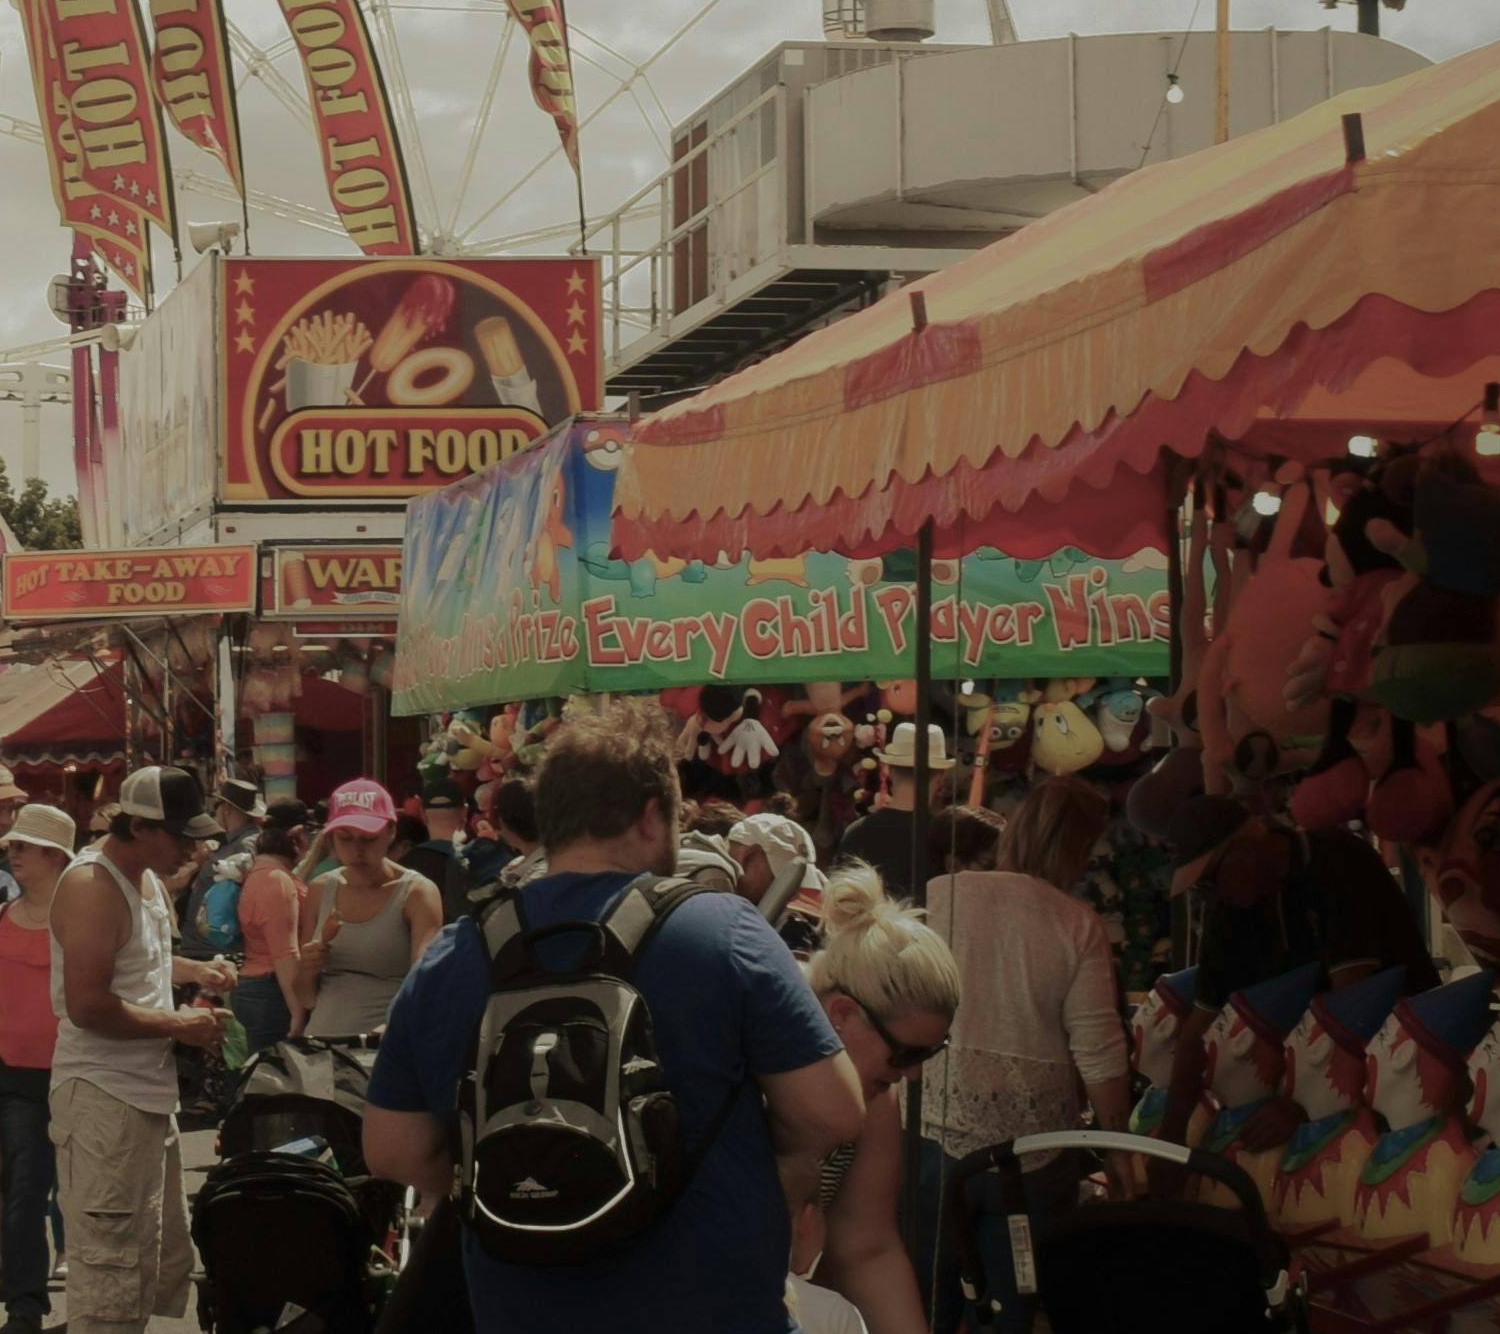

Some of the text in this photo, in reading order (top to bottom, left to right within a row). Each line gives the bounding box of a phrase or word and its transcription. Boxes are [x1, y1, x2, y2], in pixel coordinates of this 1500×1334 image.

[62, 40, 148, 170] HOT
[328, 135, 400, 247] HOT
[299, 428, 531, 475] HOT FOOD
[15, 554, 243, 599] HOT TAKE-AWAY
[106, 581, 186, 605] FOOD
[508, 586, 580, 668] Prize
[582, 564, 1170, 679] Every Child Payer Wins
